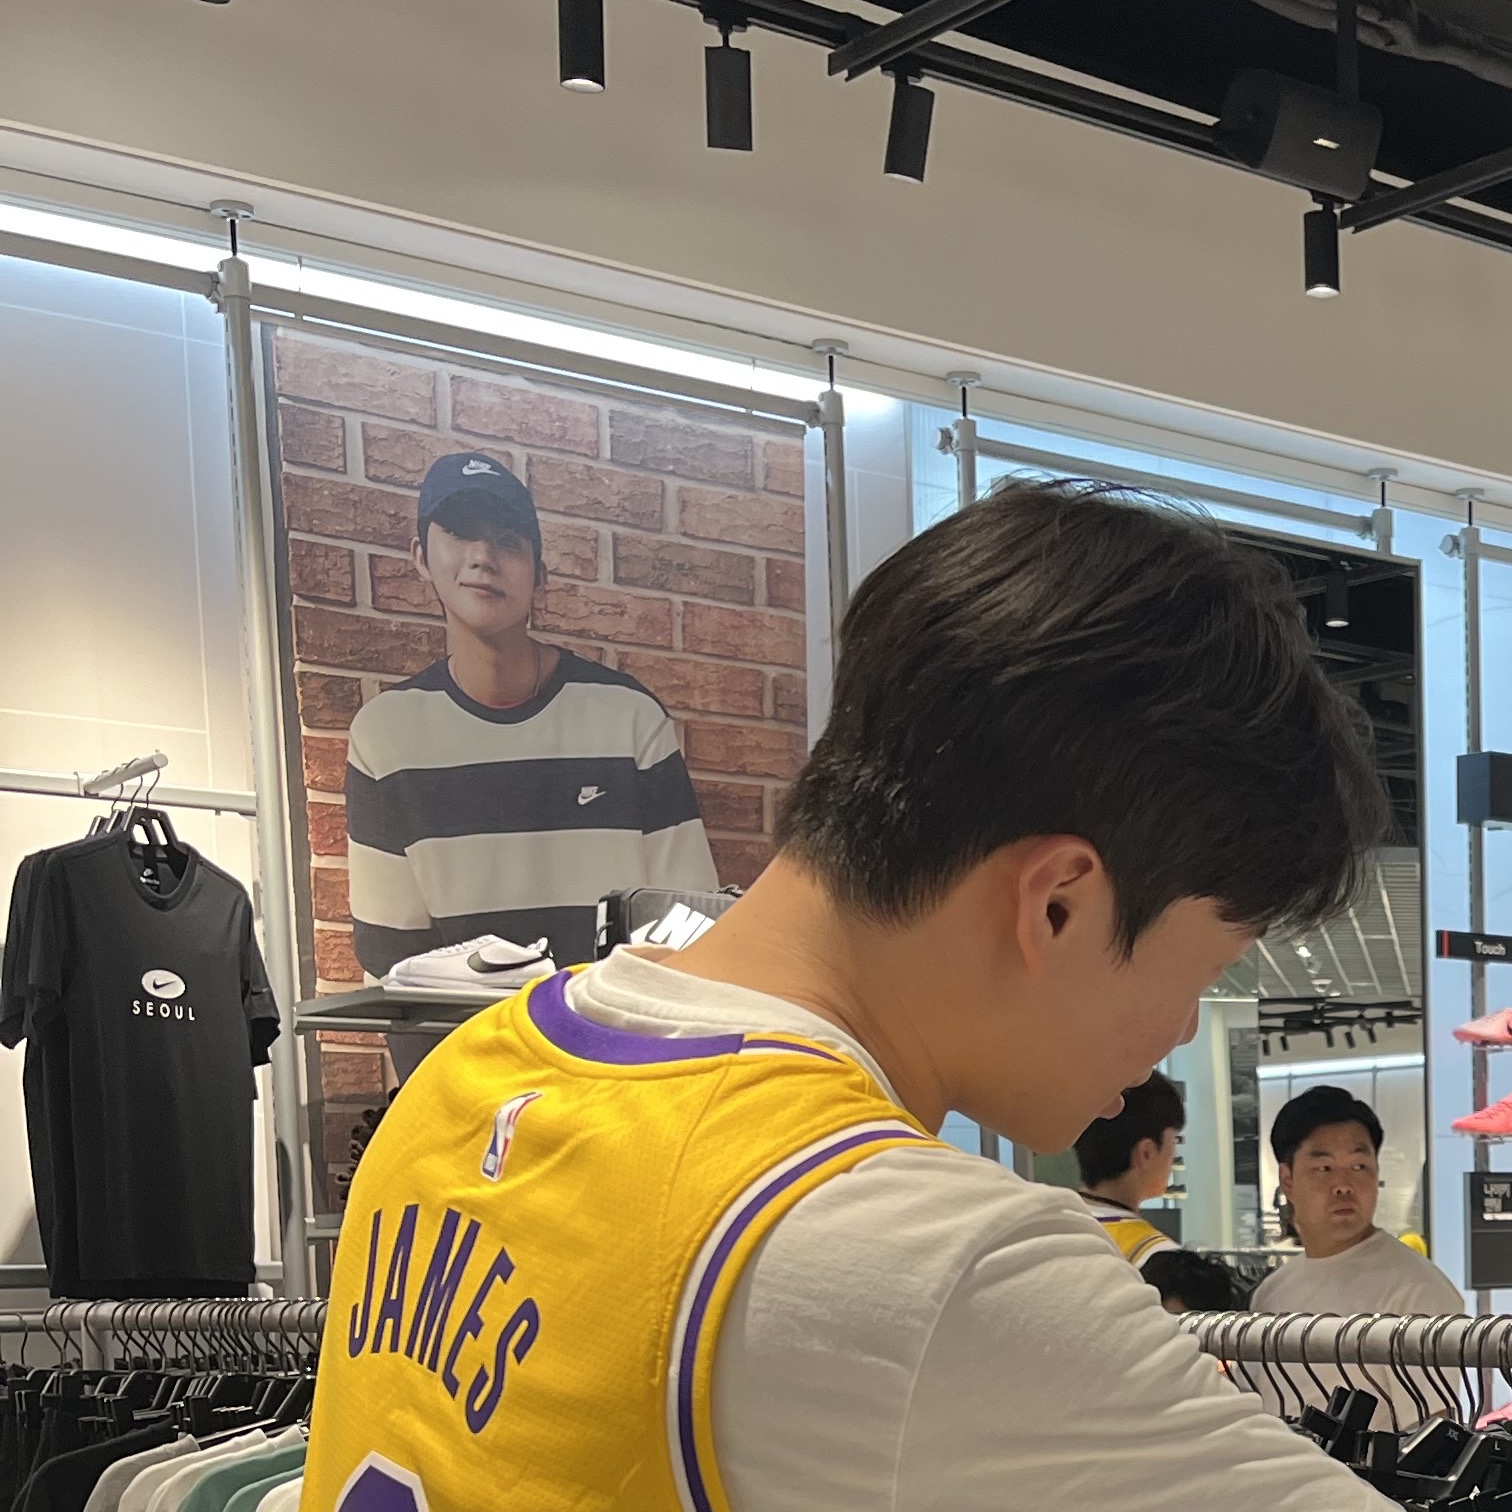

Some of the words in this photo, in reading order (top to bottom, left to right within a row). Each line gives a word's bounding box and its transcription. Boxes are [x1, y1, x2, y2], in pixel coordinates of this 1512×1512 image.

[1474, 940, 1507, 957] Touch
[132, 1000, 196, 1022] SEOUL
[348, 1202, 541, 1435] JAMES
[1494, 1440, 1501, 1451] L
